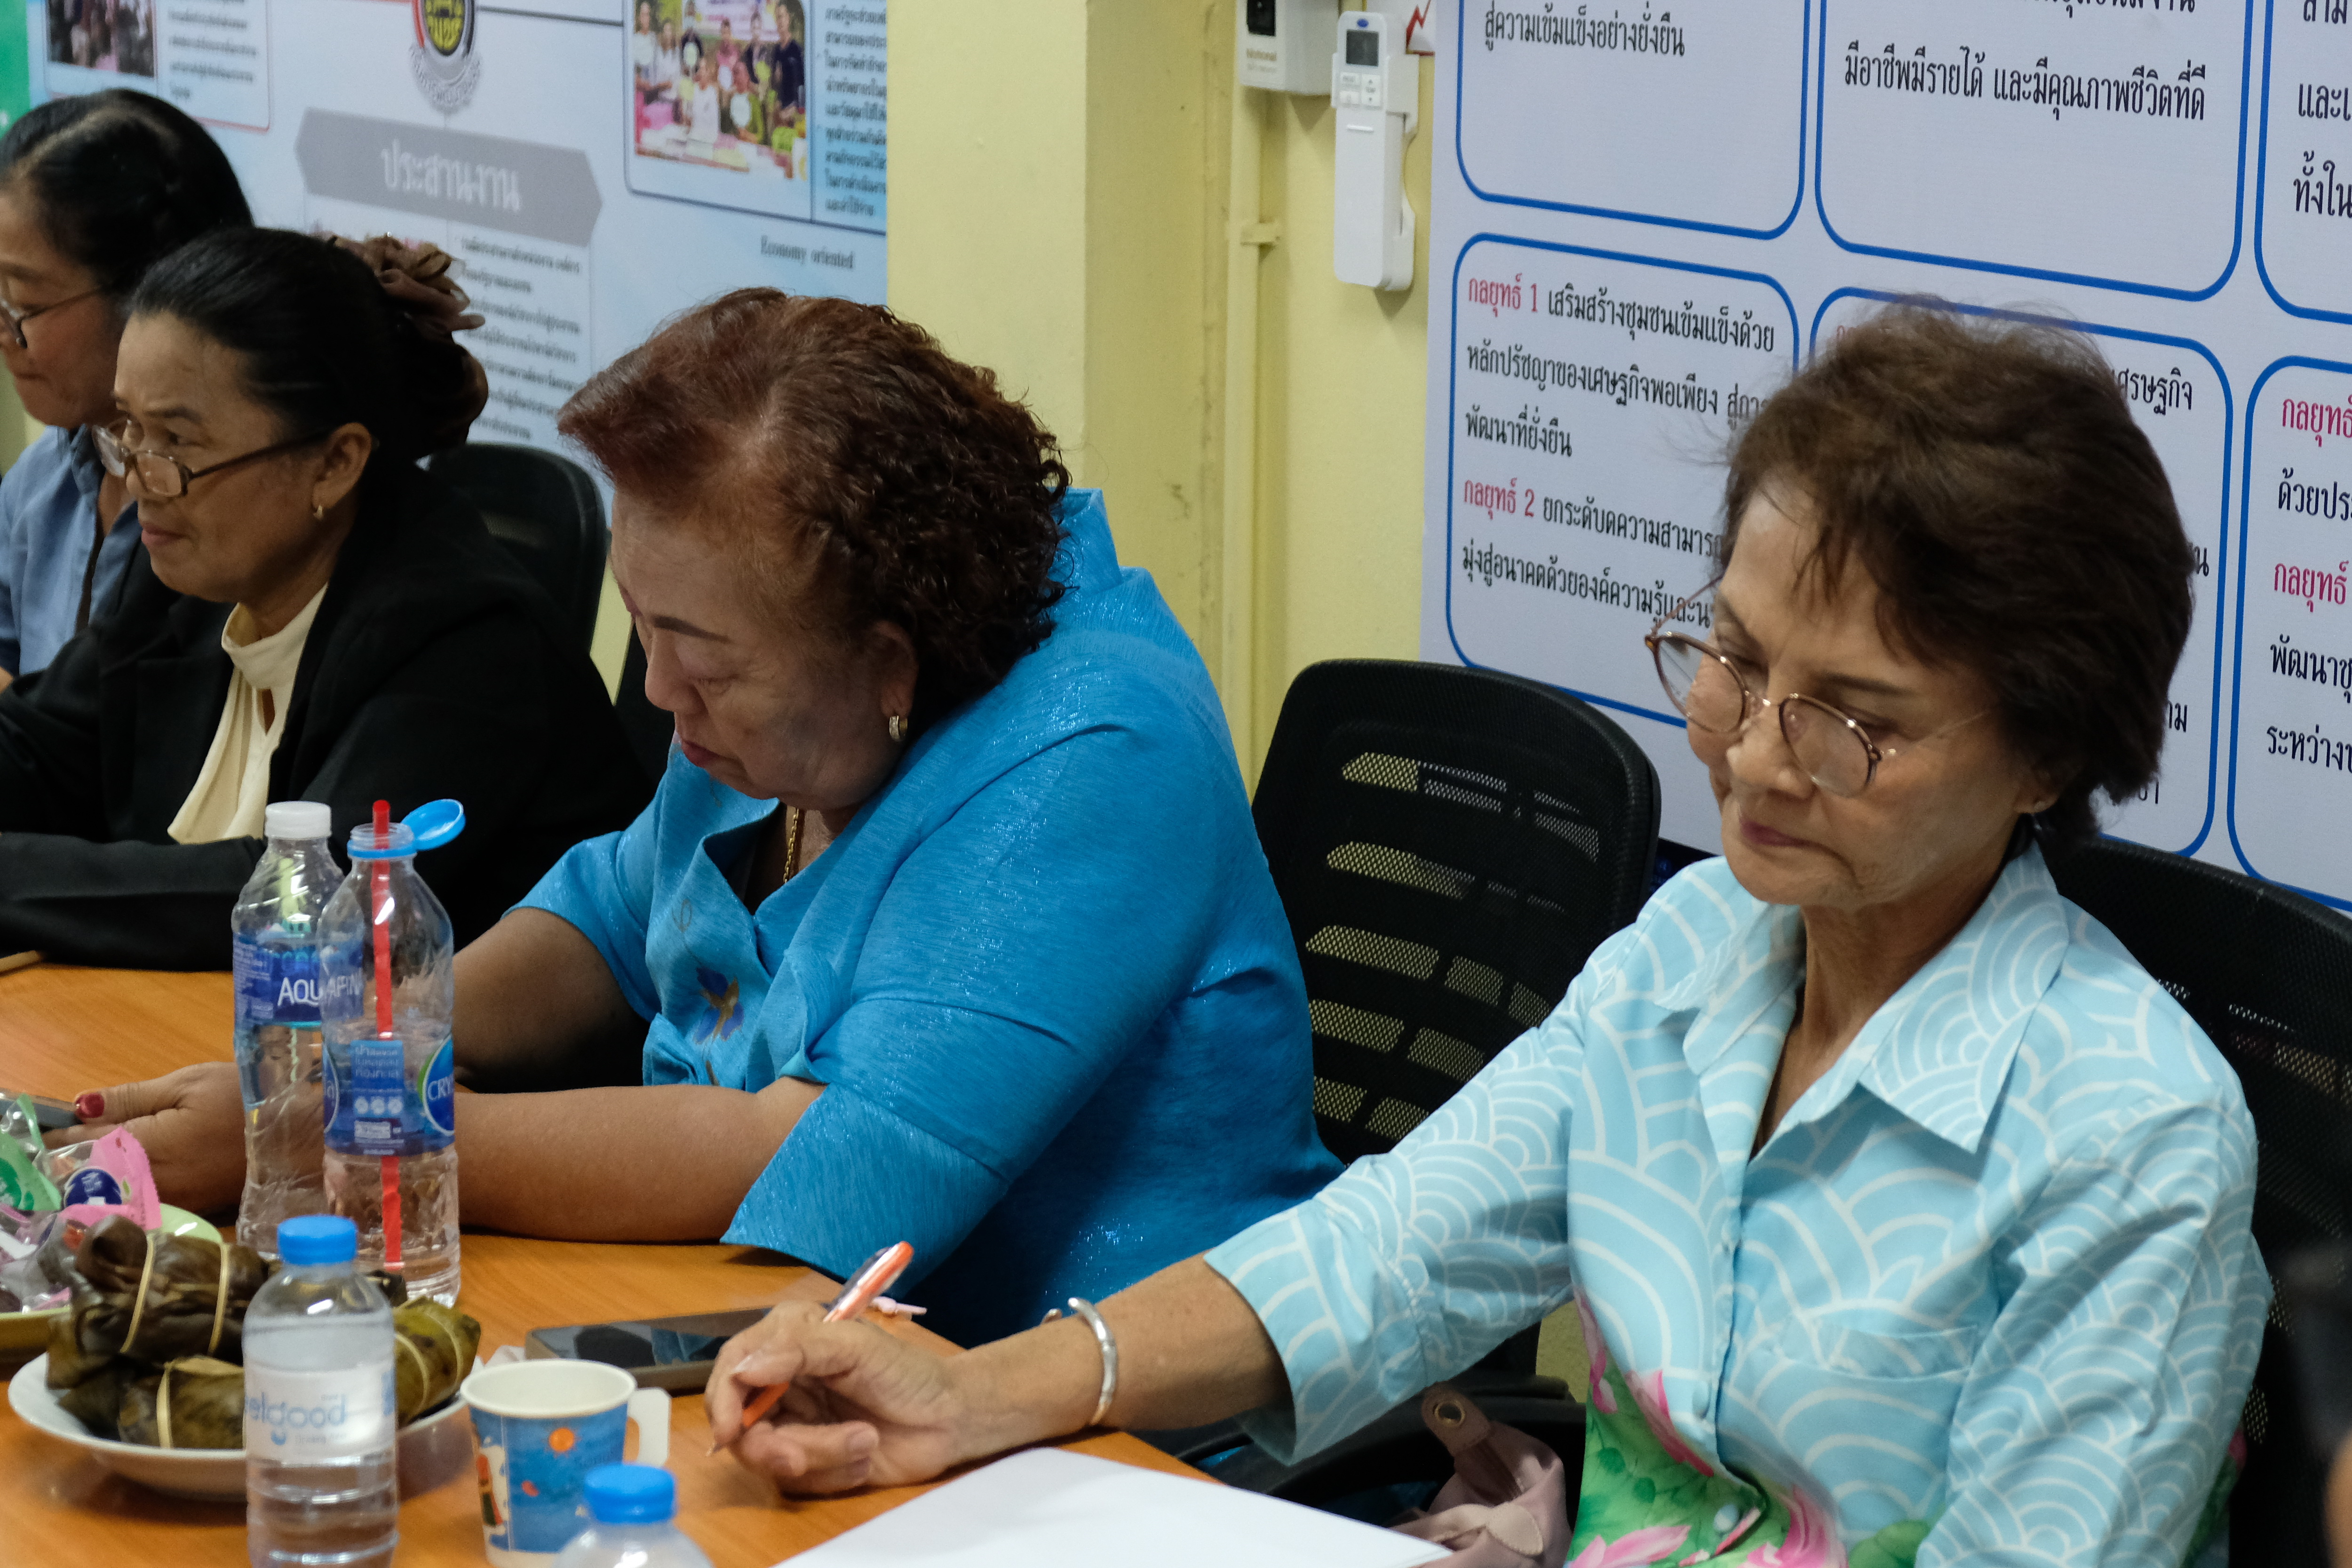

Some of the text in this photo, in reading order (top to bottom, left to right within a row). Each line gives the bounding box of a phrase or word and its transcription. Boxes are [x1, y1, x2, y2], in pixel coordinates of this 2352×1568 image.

[1485, 0, 1685, 57] สู่ความเข้มแข็งอย่างยั่งยืน
[1845, 40, 2206, 120] มีอาชีพมีรายได้ และมีคุณภาพชีวิตที่ดี
[381, 138, 520, 212] ประสานงาน
[1469, 273, 1774, 352] กลยุทธ์ 1 เสริมสร้างชุมชนเข้มแข็งด้วย
[2111, 367, 2192, 416] ศรษฐกิจ
[1465, 405, 1573, 457] พัฒนาที่ยั่งยืน
[1464, 478, 1518, 519] กลยุทธ์
[1525, 489, 1535, 517] 2
[2278, 467, 2352, 521] ด้วยปร
[2274, 560, 2349, 613] กลยุทธ์
[427, 1074, 454, 1101] CRY
